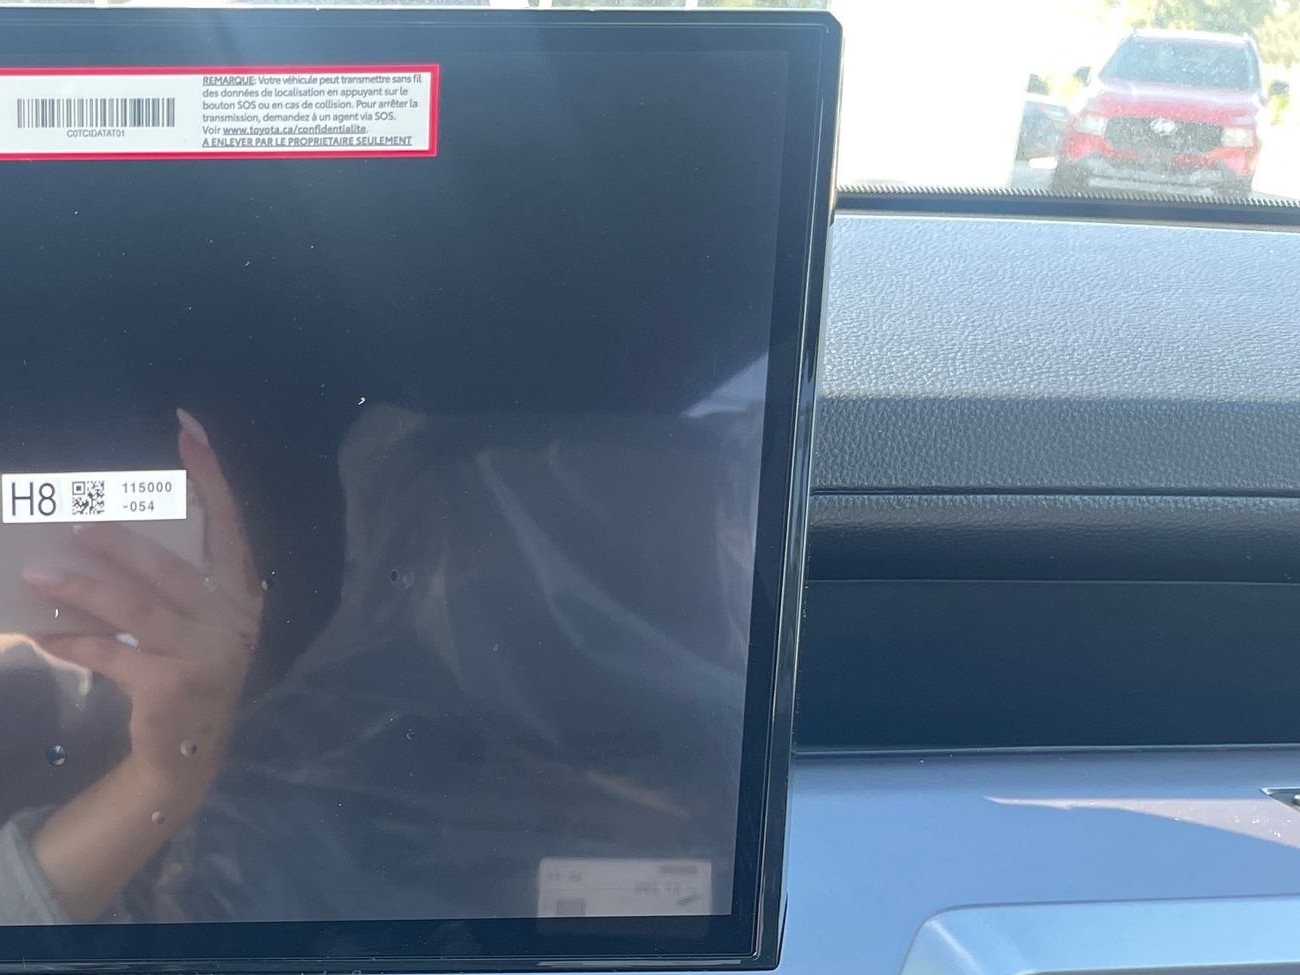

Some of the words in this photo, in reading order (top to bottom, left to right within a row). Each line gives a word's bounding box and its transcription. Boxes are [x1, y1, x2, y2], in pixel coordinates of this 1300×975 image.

[202, 76, 256, 86] REMARQUE:
[258, 76, 281, 85] Votre
[282, 75, 317, 84] véhicule
[320, 76, 339, 85] peut
[341, 76, 391, 84] transmettre
[392, 76, 411, 84] sans
[413, 74, 421, 83] fil
[202, 88, 218, 98] des
[220, 88, 259, 98] données
[261, 88, 273, 97] de
[274, 88, 325, 96] localisation
[340, 88, 382, 98] appuyant
[384, 88, 398, 96] sur
[400, 86, 408, 96] le
[202, 100, 235, 110] bouton
[237, 100, 256, 110] SOS
[258, 102, 270, 110] ou
[301, 100, 313, 109] de
[315, 100, 353, 108] collision.
[356, 100, 376, 108] Pour
[378, 100, 408, 108] arrêter
[410, 99, 418, 108] la
[202, 114, 260, 123] transmission,
[262, 113, 310, 122] demandez
[312, 112, 317, 121] à
[332, 114, 358, 122] agent
[360, 112, 372, 120] via
[374, 112, 396, 120] SOS.
[202, 126, 221, 134] Voir
[202, 138, 210, 148] A
[212, 138, 253, 148] ENLEVER
[255, 138, 274, 148] PAR
[276, 138, 286, 147] LE
[288, 137, 354, 147] PROPRIETAIRE
[356, 136, 412, 146] SEULEMENT
[122, 481, 173, 493] 115000
[10, 482, 57, 516] H8
[123, 501, 156, 512] -054
